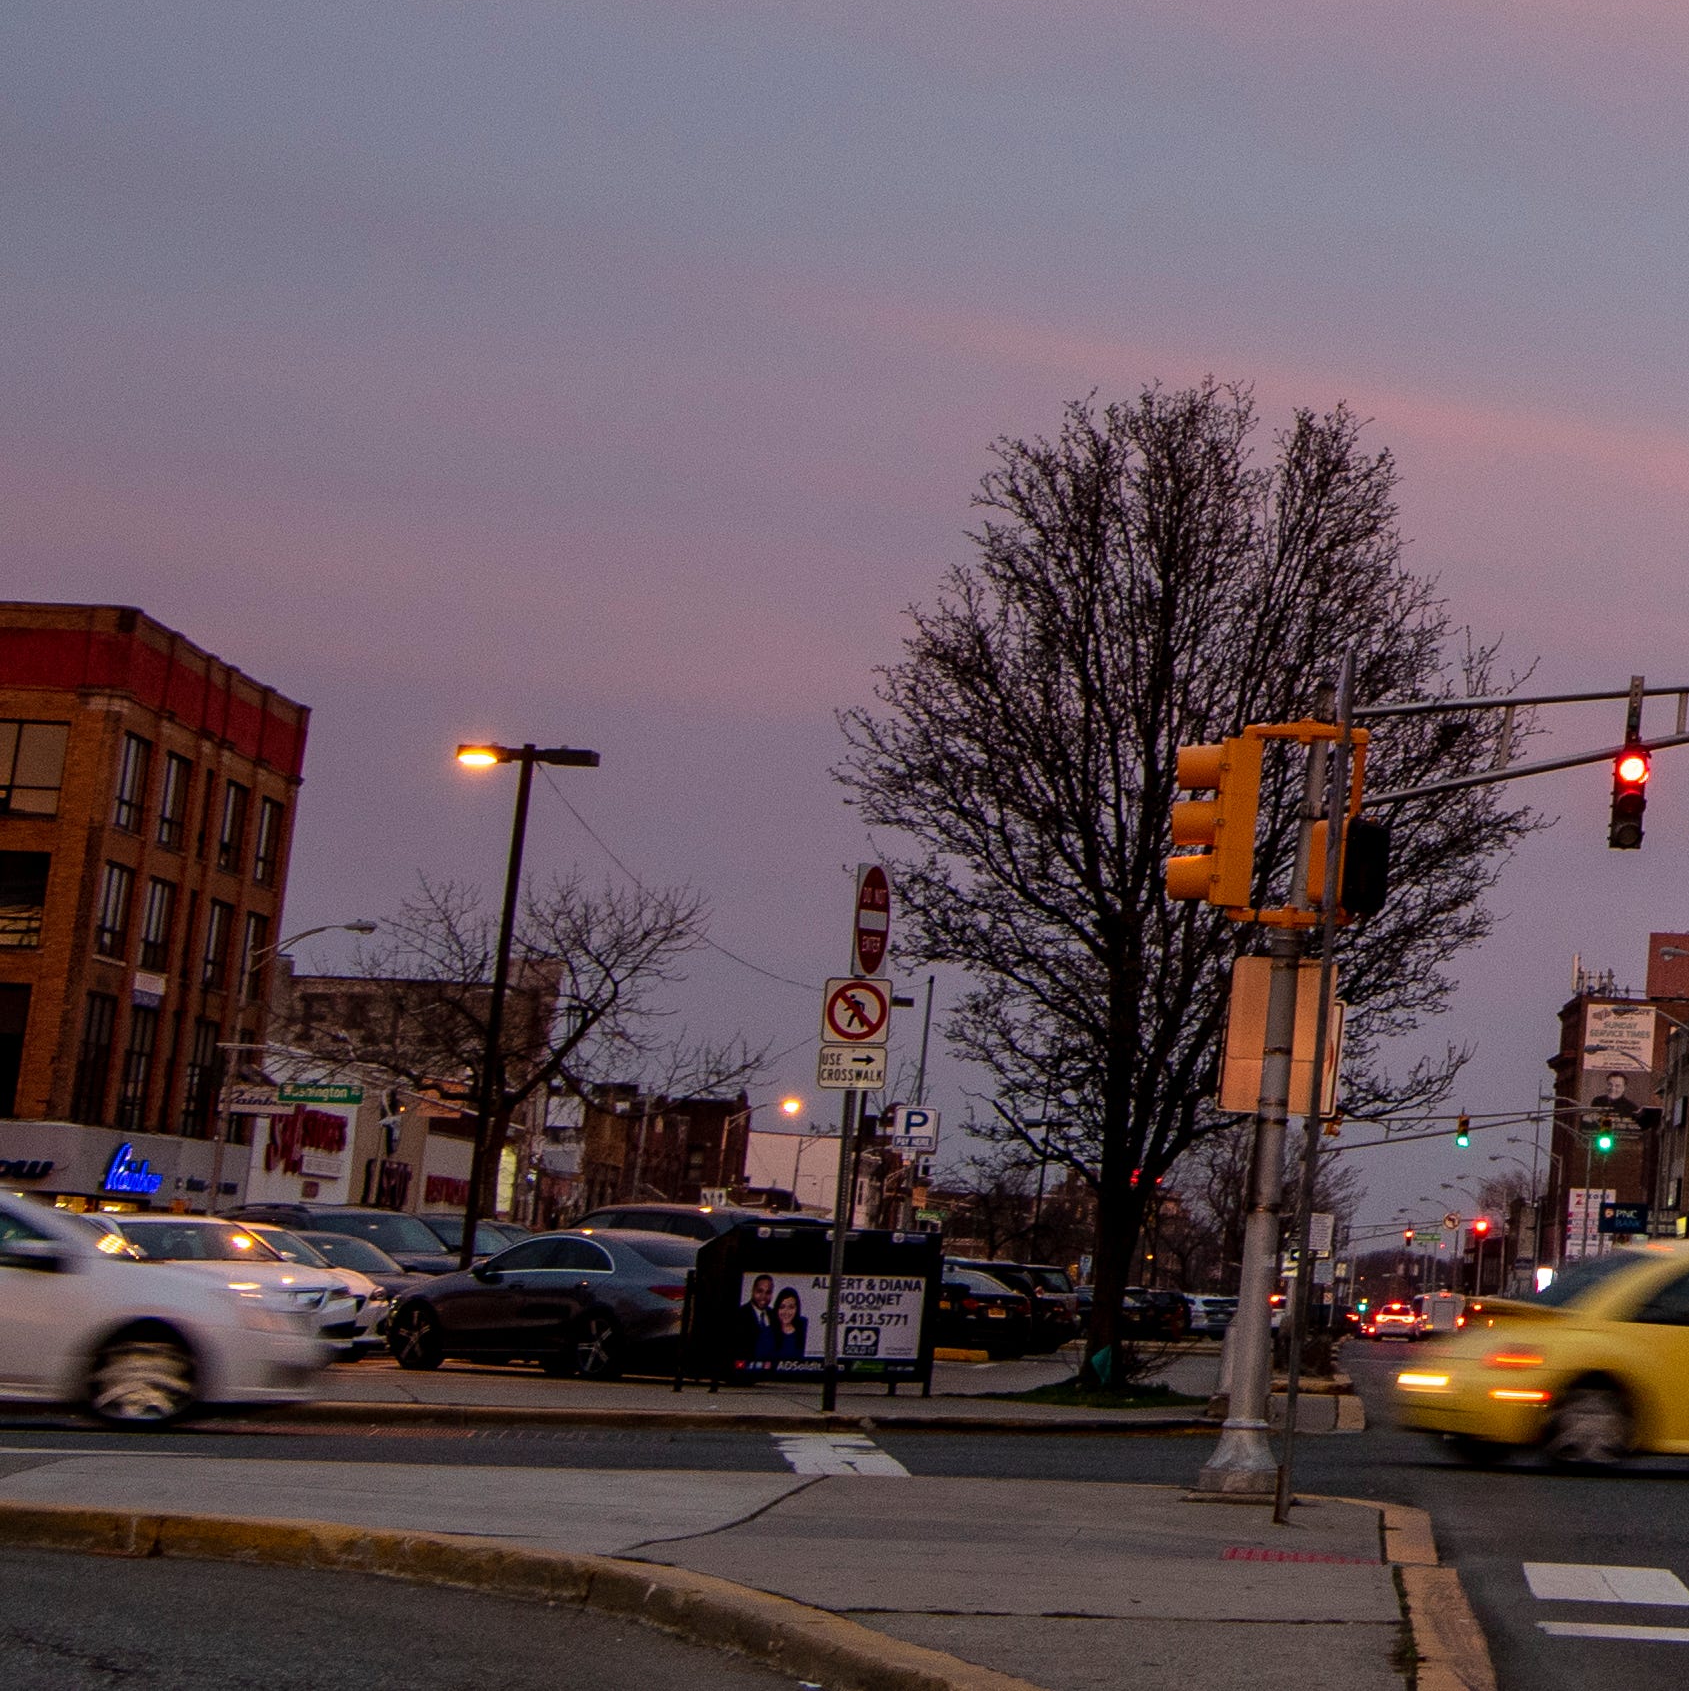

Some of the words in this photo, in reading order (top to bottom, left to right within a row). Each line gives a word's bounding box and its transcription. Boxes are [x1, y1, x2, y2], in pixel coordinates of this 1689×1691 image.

[861, 934, 882, 952] ENTER
[822, 1051, 842, 1066] USE
[820, 1066, 884, 1083] CROSSWALK
[1615, 1208, 1638, 1219] PNC
[1615, 1217, 1642, 1228] BANK
[812, 1276, 864, 1292] ALERT
[866, 1278, 876, 1292] &
[879, 1278, 922, 1293] DIANA
[840, 1292, 903, 1306] IODONET
[820, 1312, 908, 1327] 93.413.5771
